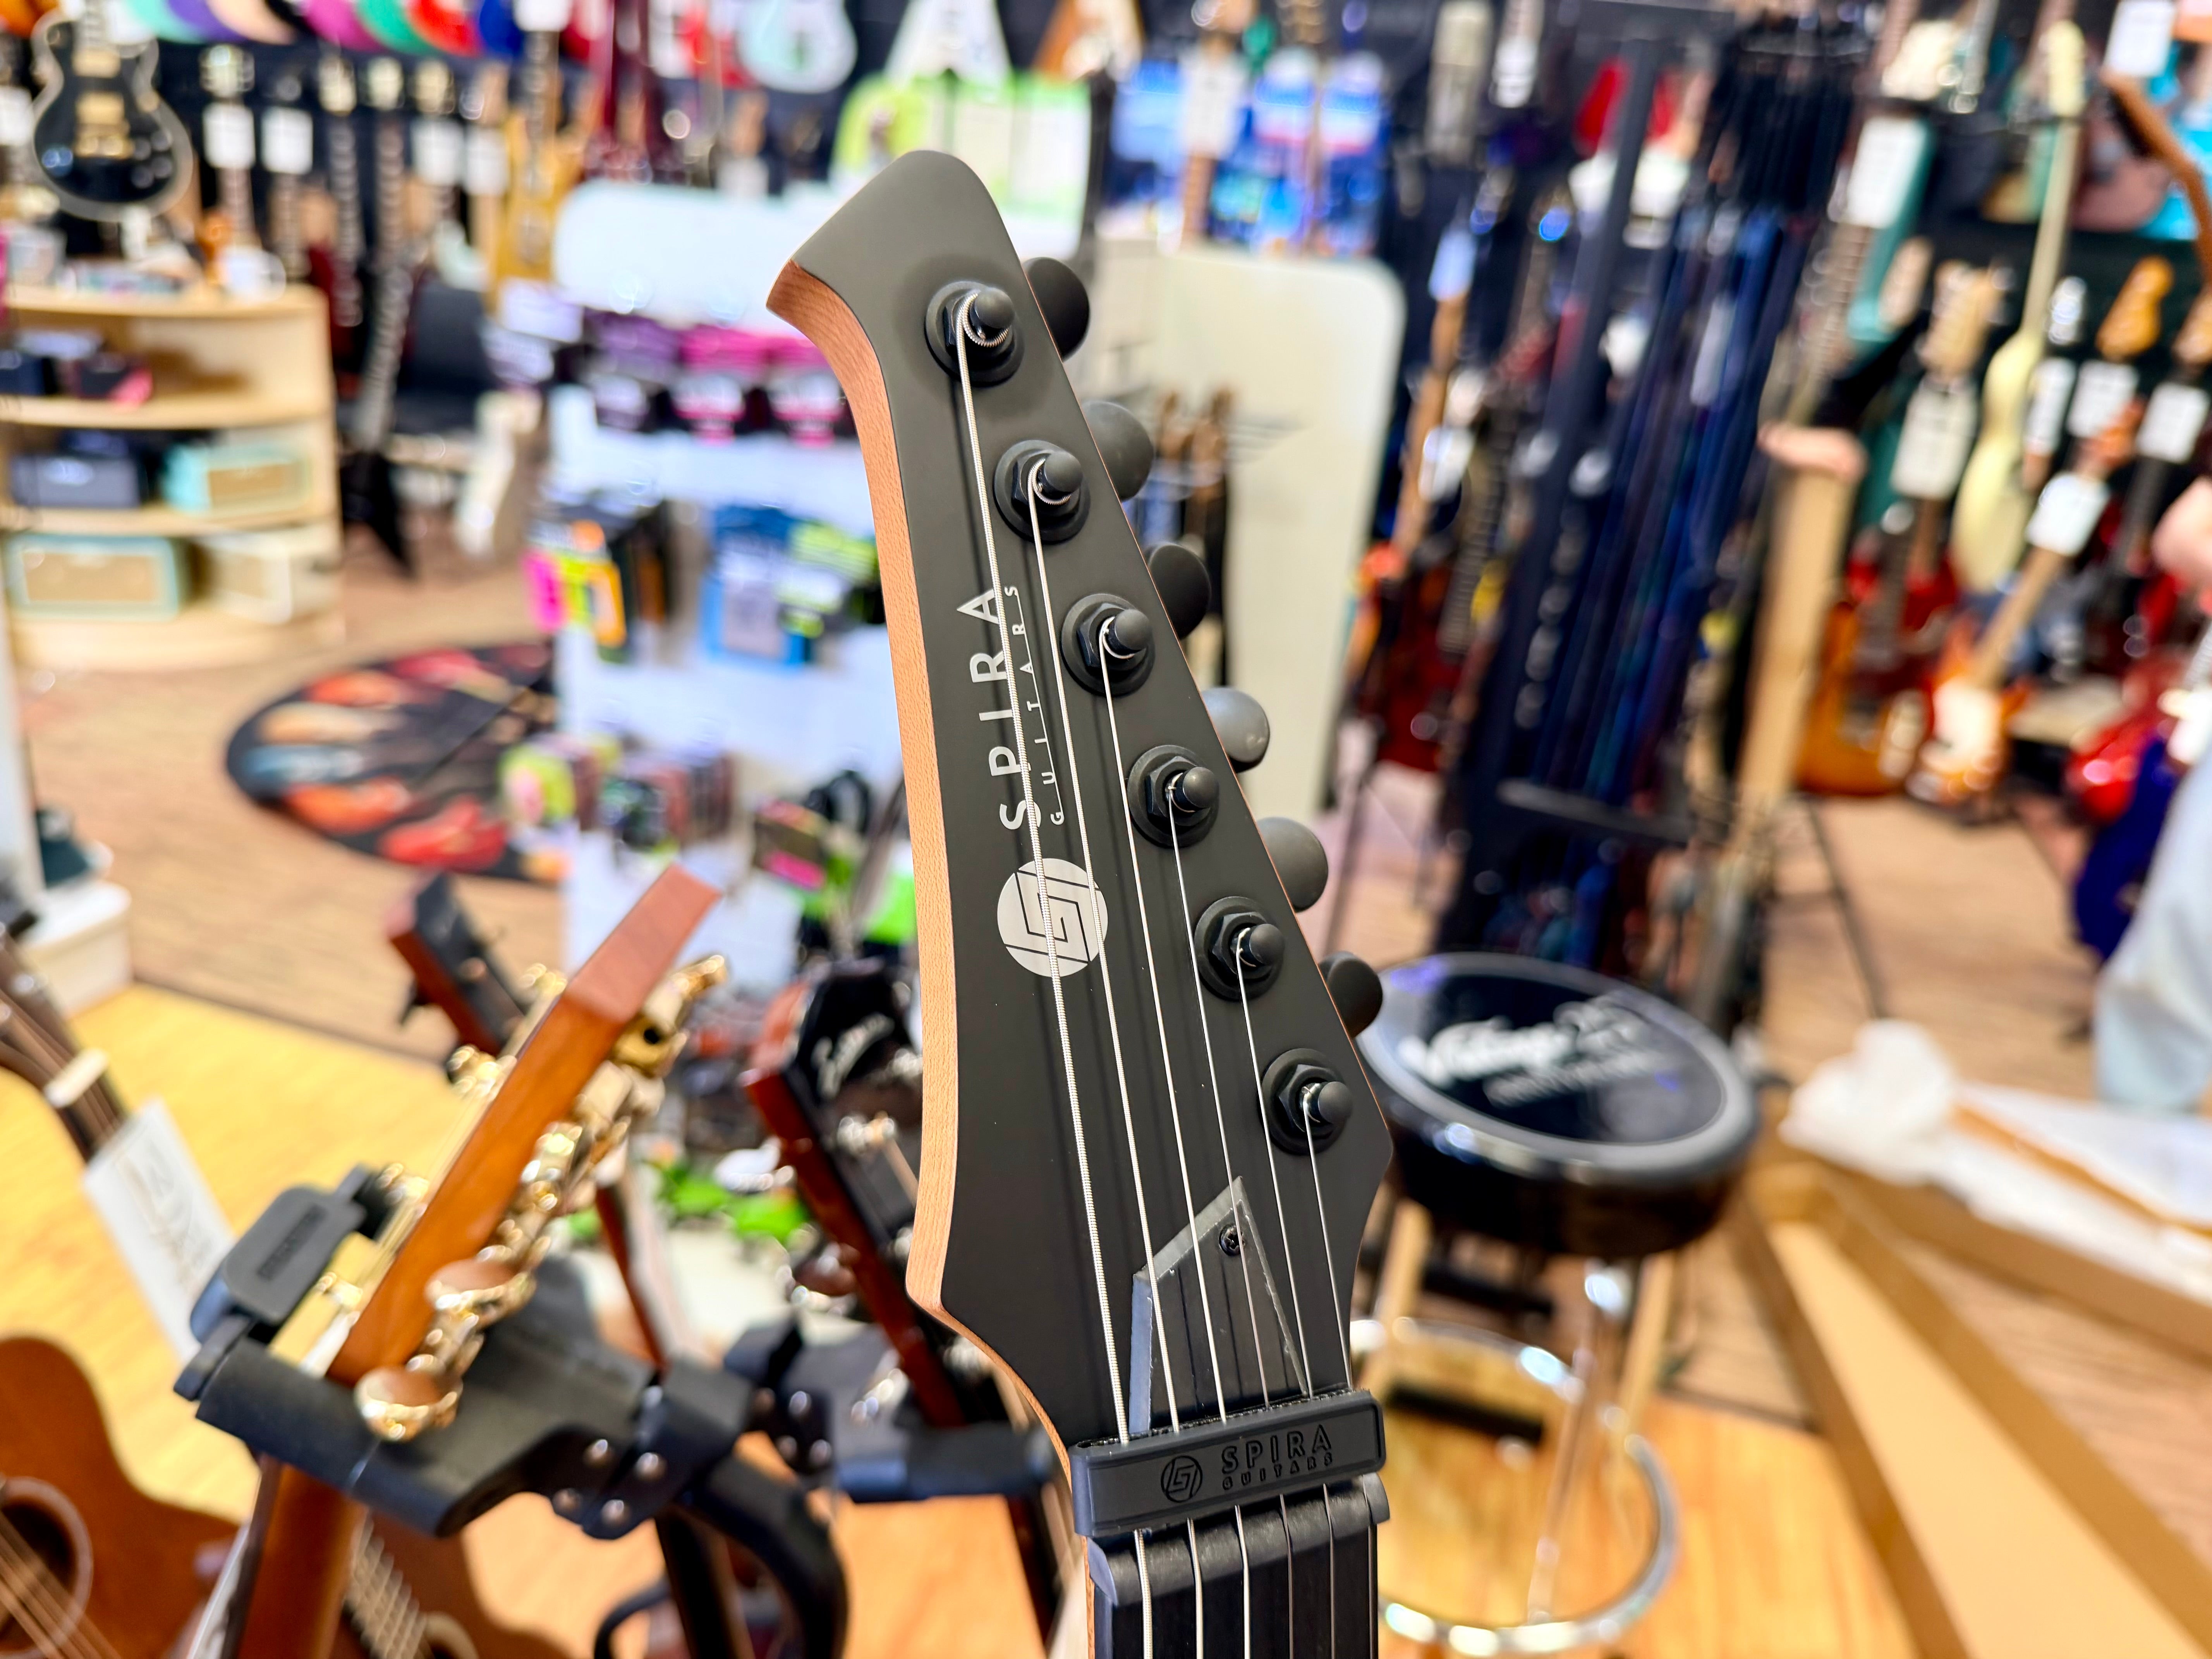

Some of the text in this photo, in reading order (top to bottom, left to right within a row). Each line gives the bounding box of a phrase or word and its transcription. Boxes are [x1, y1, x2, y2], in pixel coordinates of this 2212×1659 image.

[957, 588, 1042, 830] SPIRA
[1004, 586, 1064, 825] GUITARS
[1221, 1424, 1332, 1474] SPIRA
[1223, 1453, 1333, 1490] GUITARS
